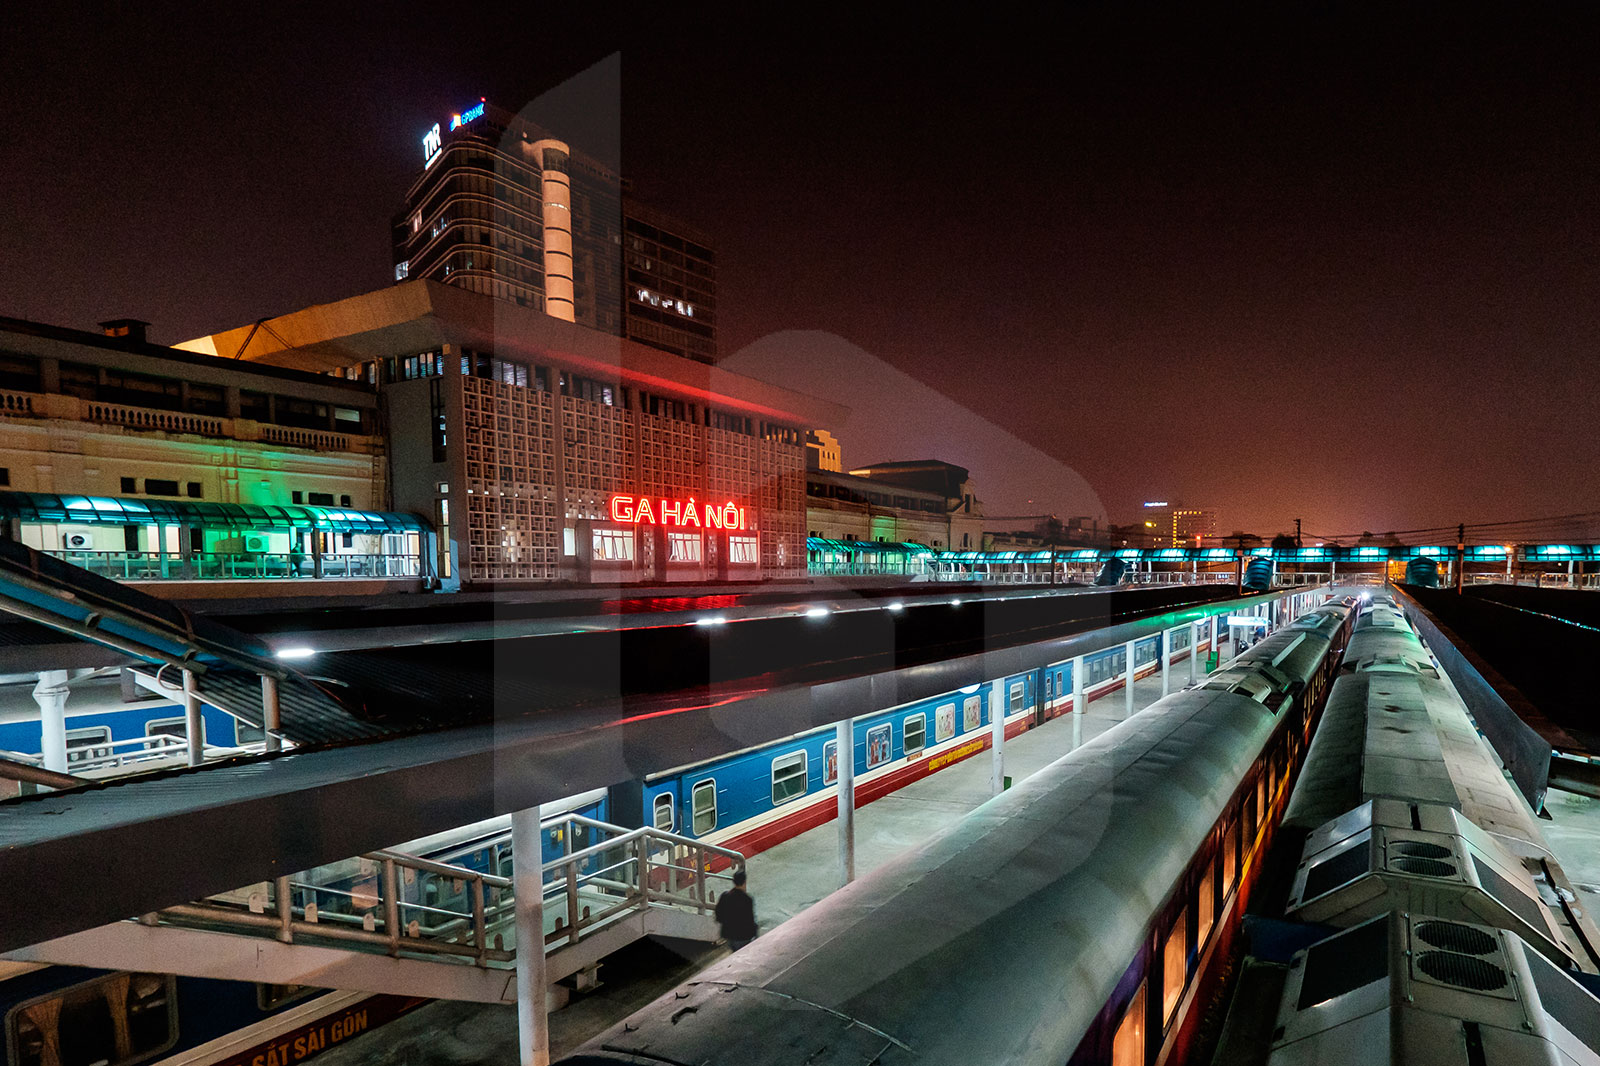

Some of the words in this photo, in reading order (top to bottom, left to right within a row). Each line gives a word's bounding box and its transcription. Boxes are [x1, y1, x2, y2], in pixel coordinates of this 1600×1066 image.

[423, 122, 442, 161] TNR
[611, 495, 656, 524] GA
[661, 497, 701, 527] HÀ
[294, 1027, 326, 1060] SÀI
[331, 1009, 368, 1043] GÒN
